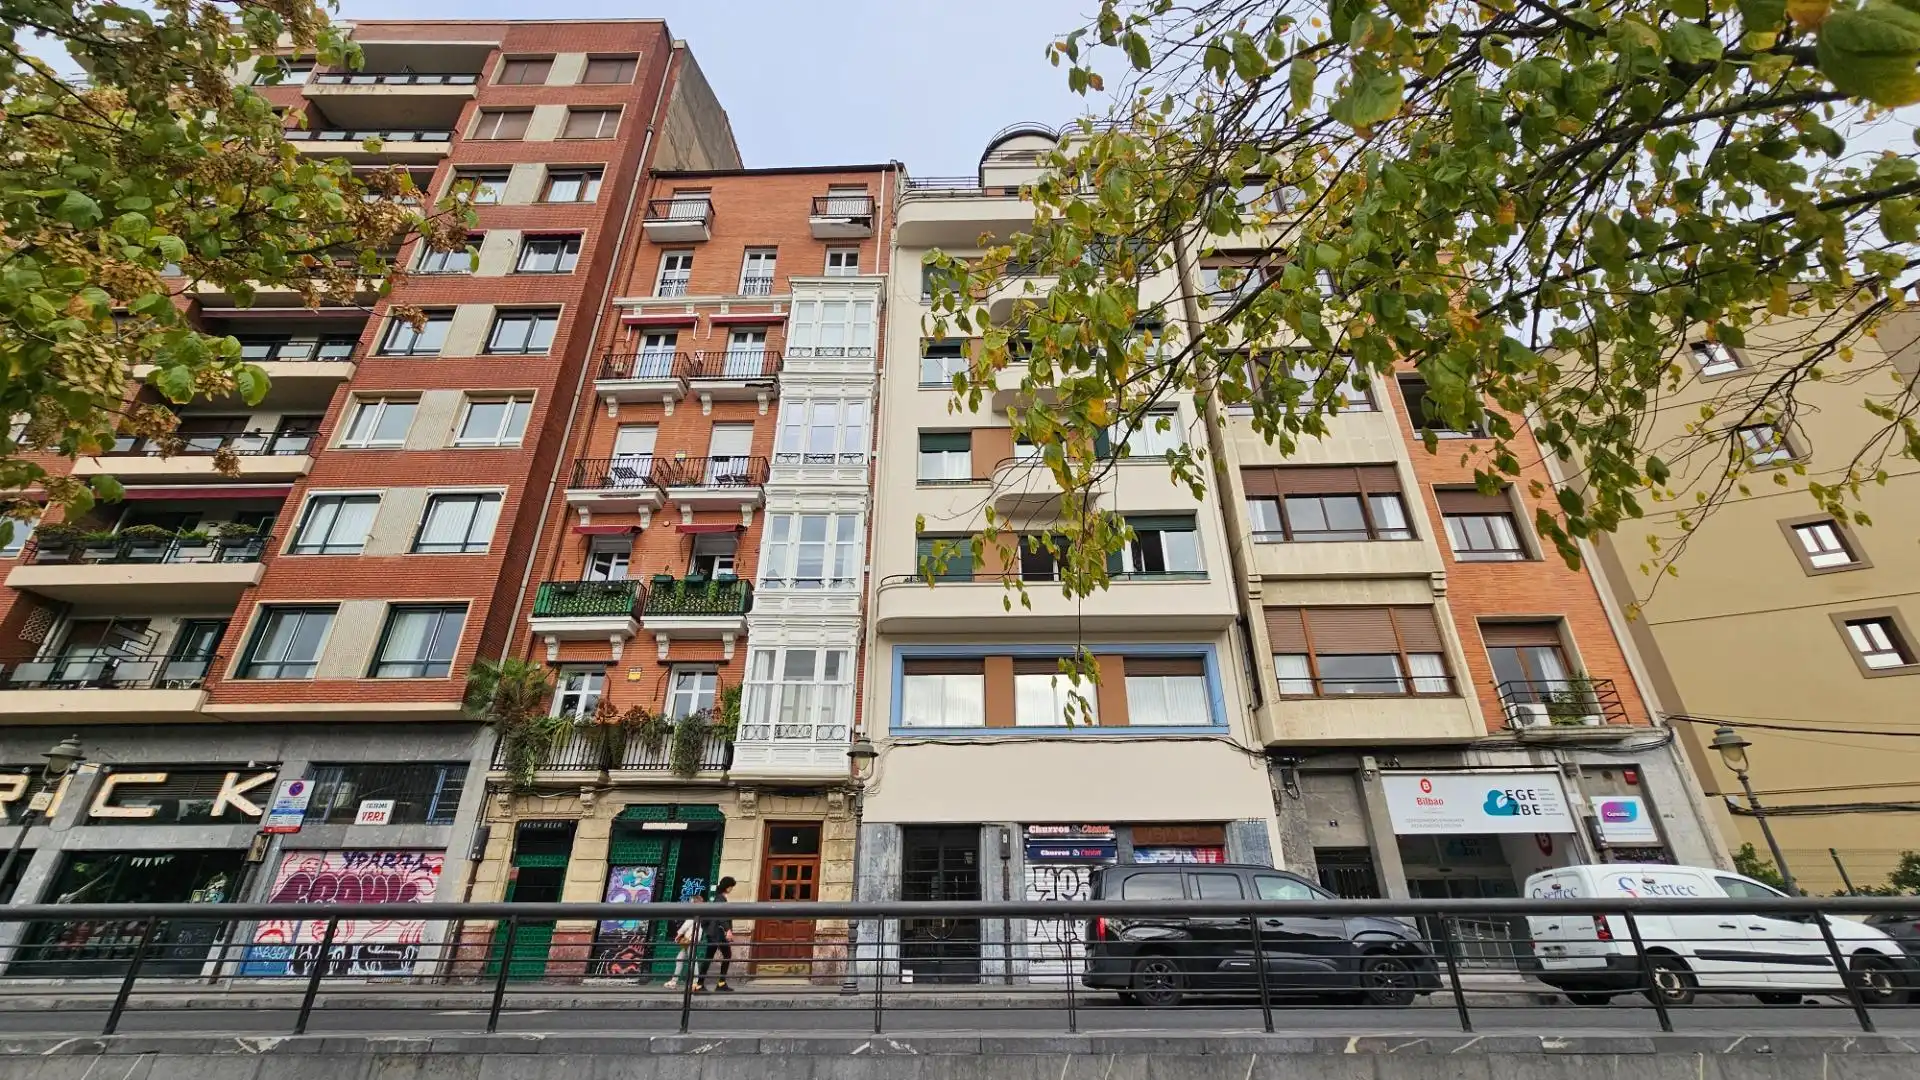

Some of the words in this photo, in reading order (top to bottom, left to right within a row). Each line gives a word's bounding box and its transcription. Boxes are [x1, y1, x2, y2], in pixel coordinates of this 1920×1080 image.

[1504, 789, 1537, 801] EGE
[1416, 797, 1444, 806] Bilbao
[1509, 803, 1542, 816] ZBE
[1028, 824, 1070, 834] Churros
[1040, 849, 1070, 857] Churros
